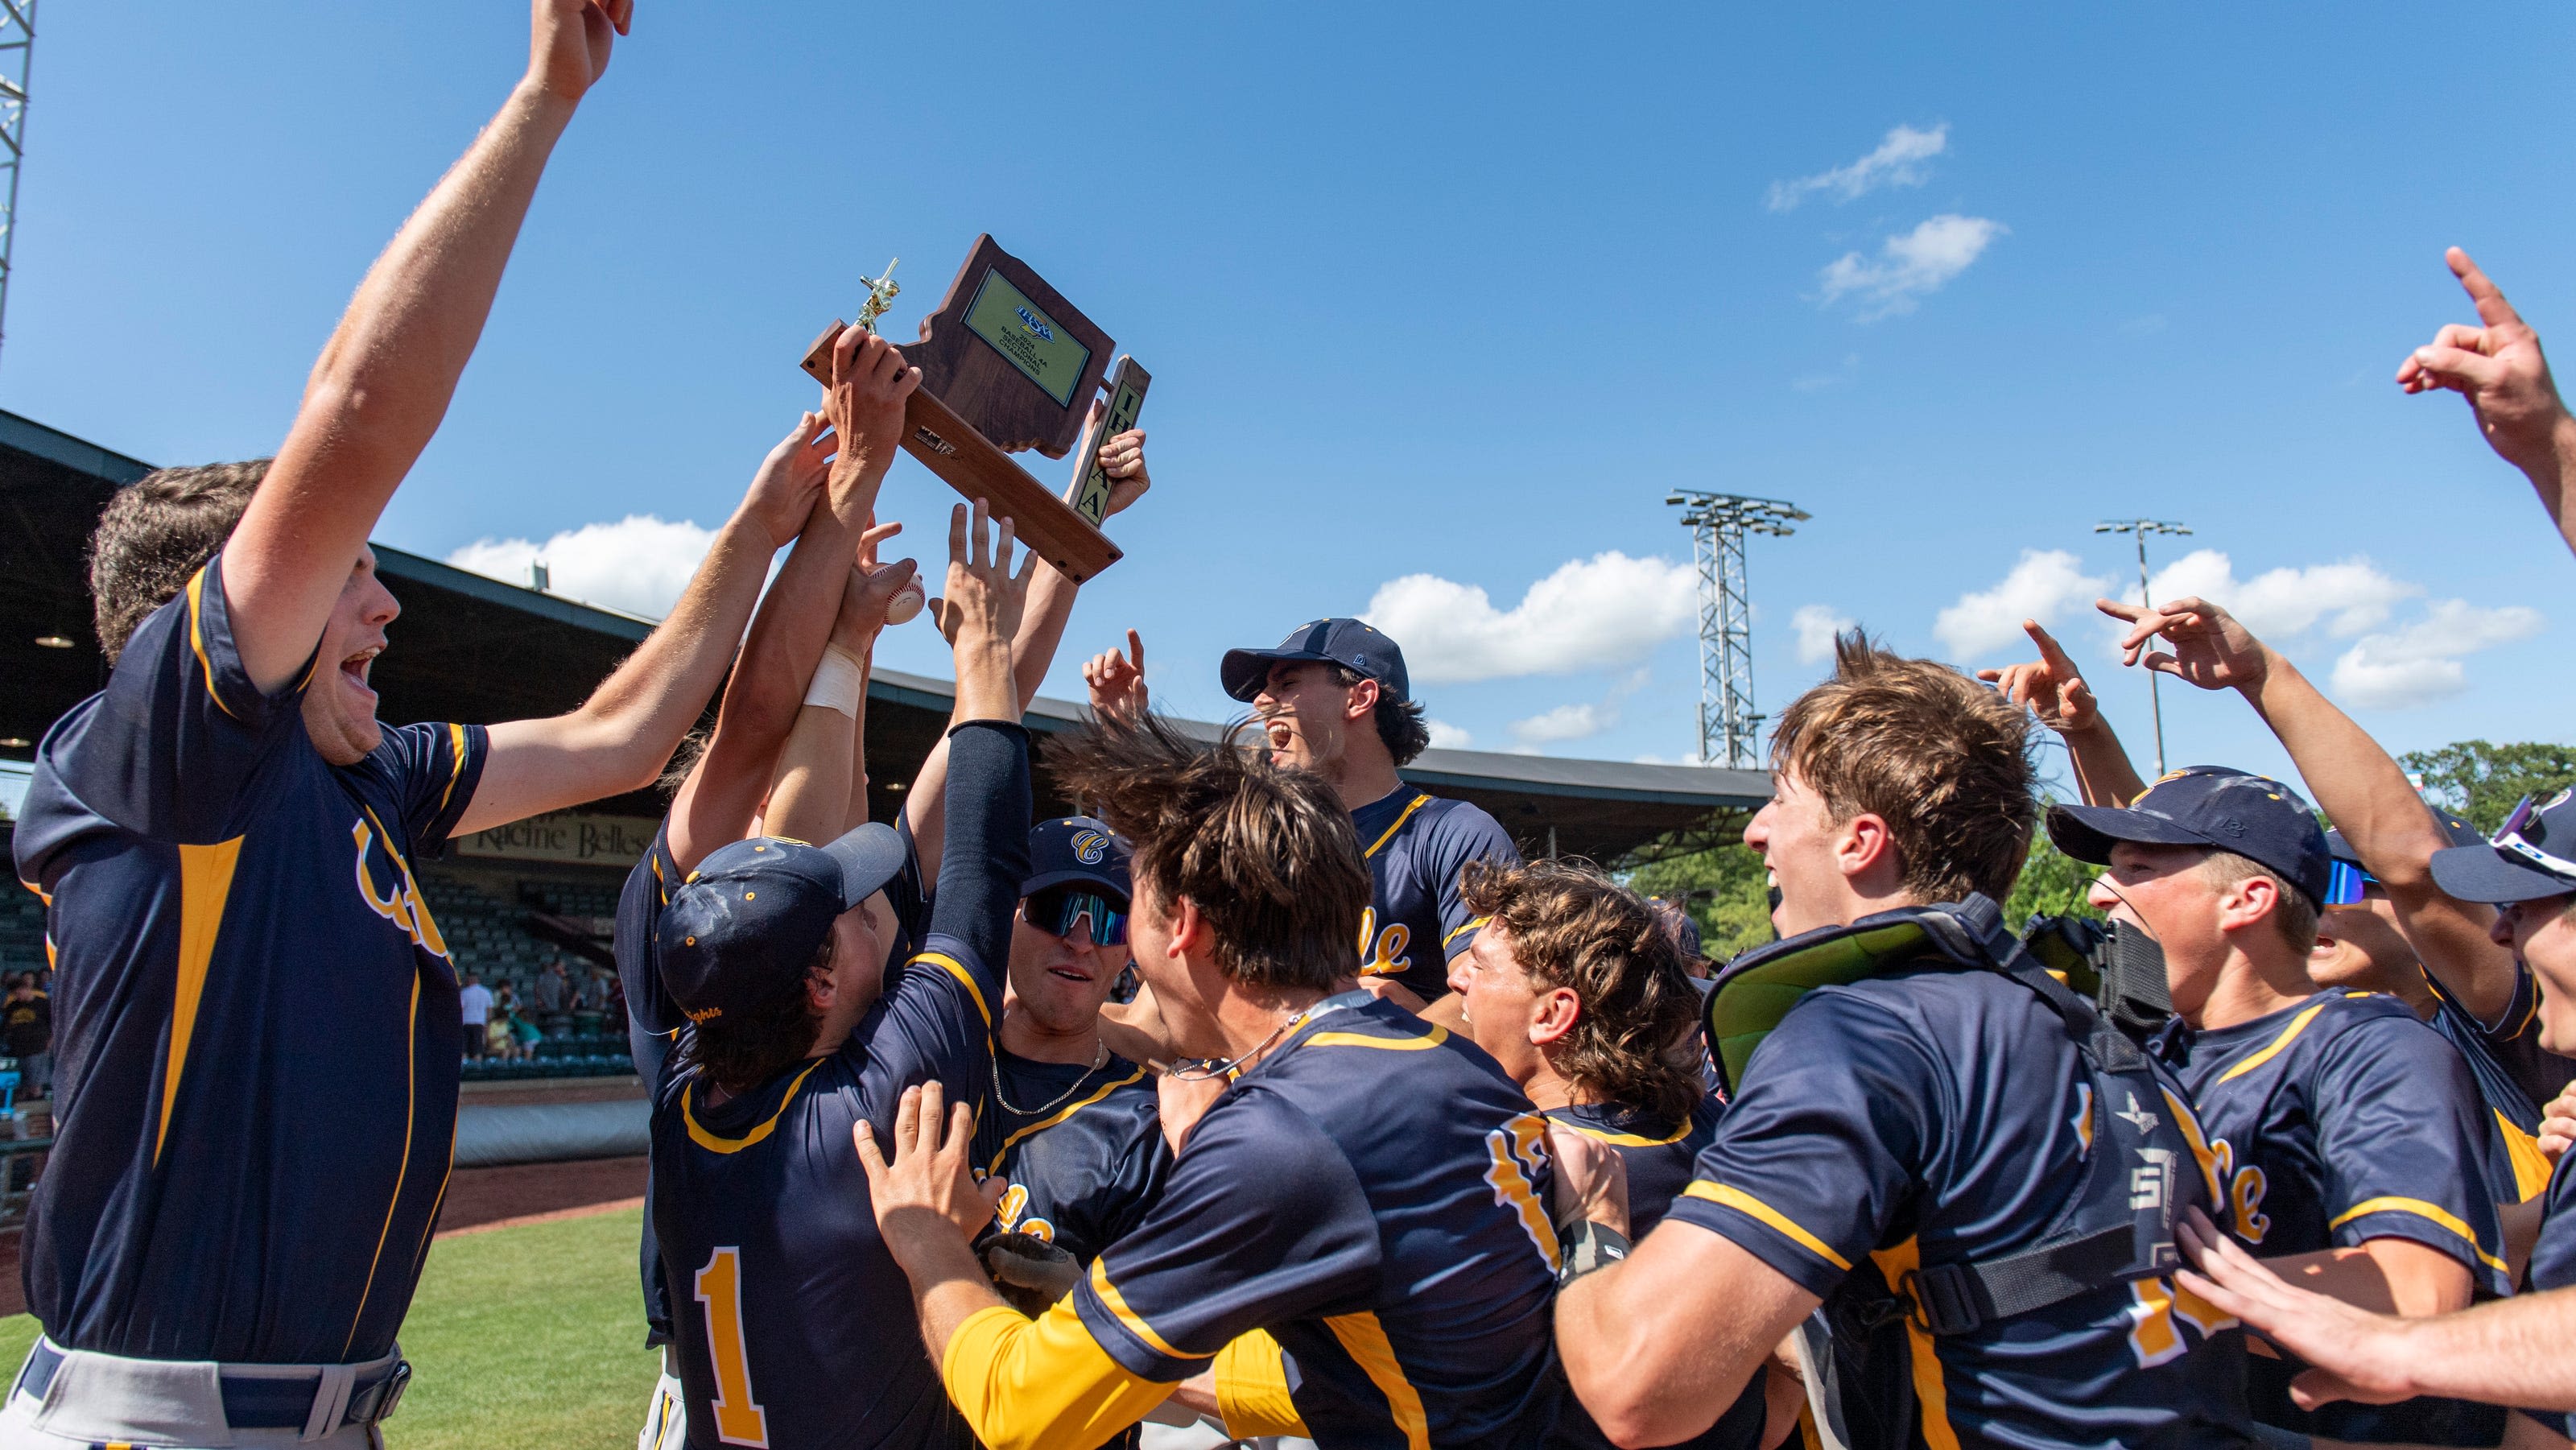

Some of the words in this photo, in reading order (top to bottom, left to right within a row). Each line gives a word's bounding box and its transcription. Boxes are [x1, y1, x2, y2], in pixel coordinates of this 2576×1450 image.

[999, 339, 1041, 375] CHAMPIONS
[1001, 326, 1038, 360] BASEBALL
[1038, 358, 1048, 368] 4A
[1002, 334, 1041, 370] SECTIONAL
[1019, 334, 1035, 349] 2024
[1082, 395, 1134, 518] IHAA
[694, 1246, 770, 1450] 1
